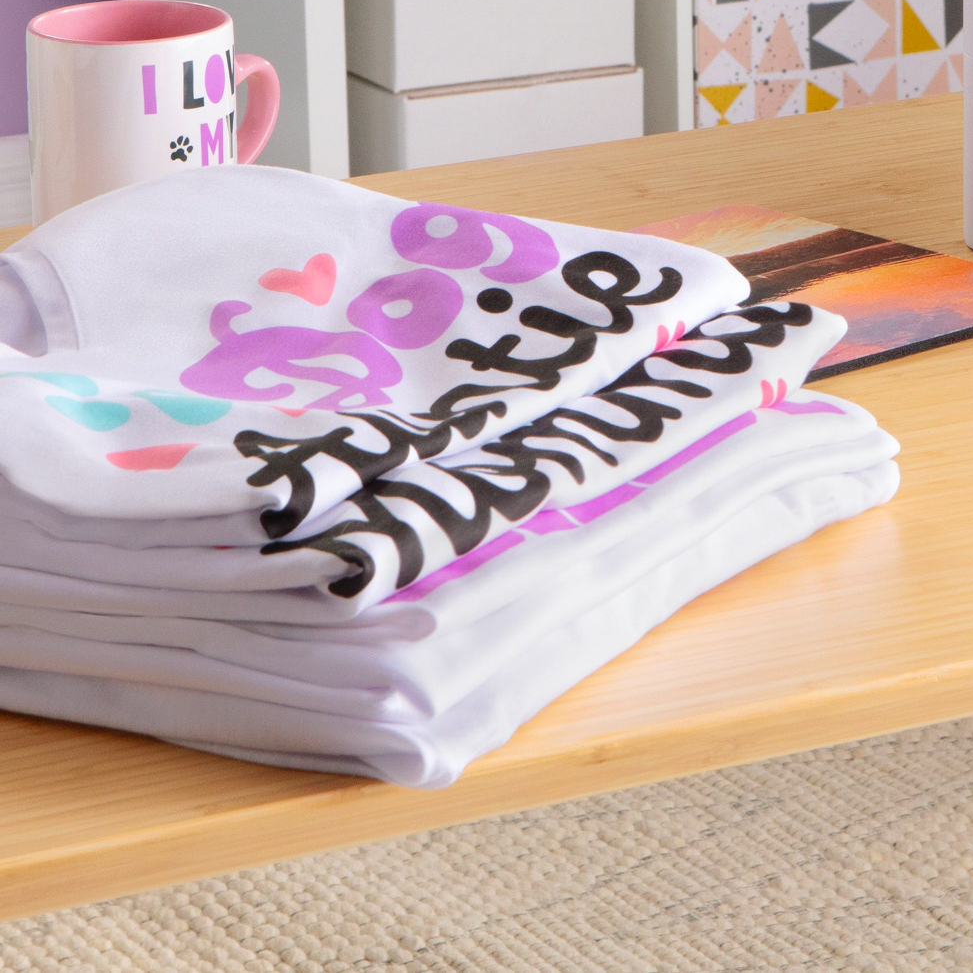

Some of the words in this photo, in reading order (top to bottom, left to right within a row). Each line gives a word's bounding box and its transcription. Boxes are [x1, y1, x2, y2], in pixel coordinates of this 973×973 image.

[142, 64, 157, 115] I
[179, 201, 560, 411] Dog
[233, 251, 683, 540] Auntie
